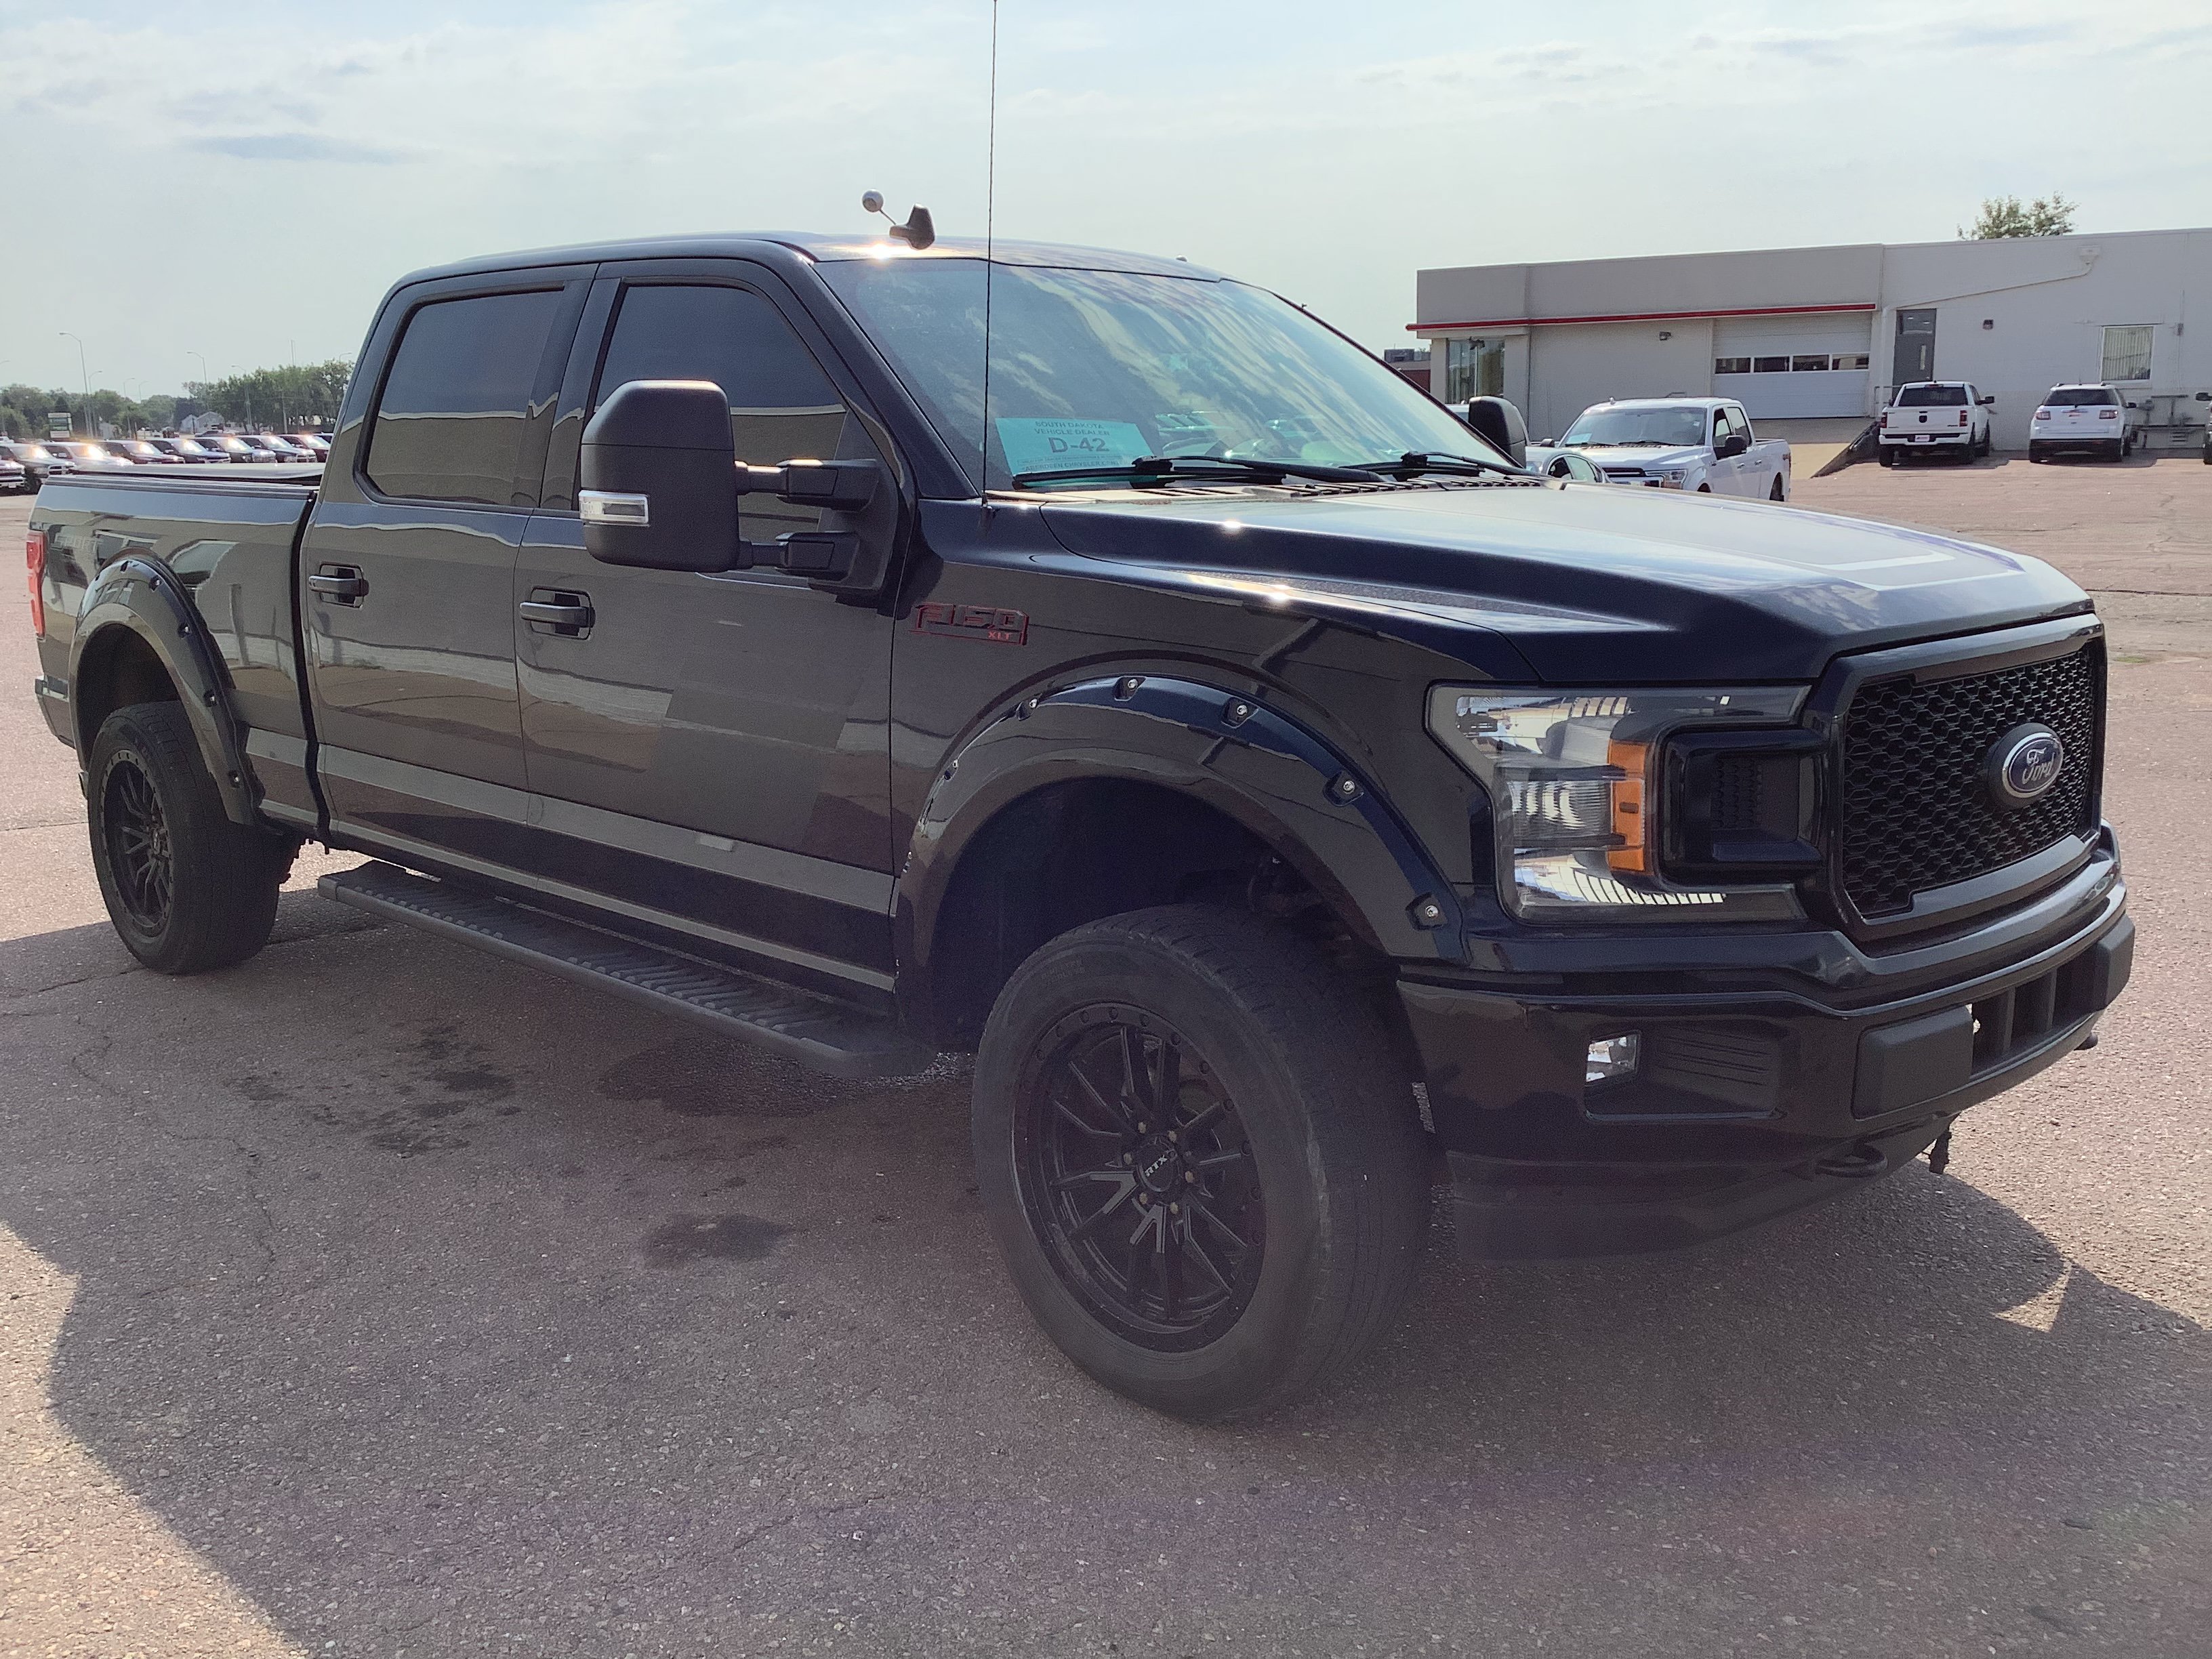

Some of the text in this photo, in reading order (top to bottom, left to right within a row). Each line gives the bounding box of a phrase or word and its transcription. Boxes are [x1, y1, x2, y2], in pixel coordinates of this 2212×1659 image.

[1048, 437, 1109, 453] D-42
[988, 632, 1011, 641] XLT
[2022, 747, 2055, 785] Ford
[1145, 1155, 1168, 1177] RTX
